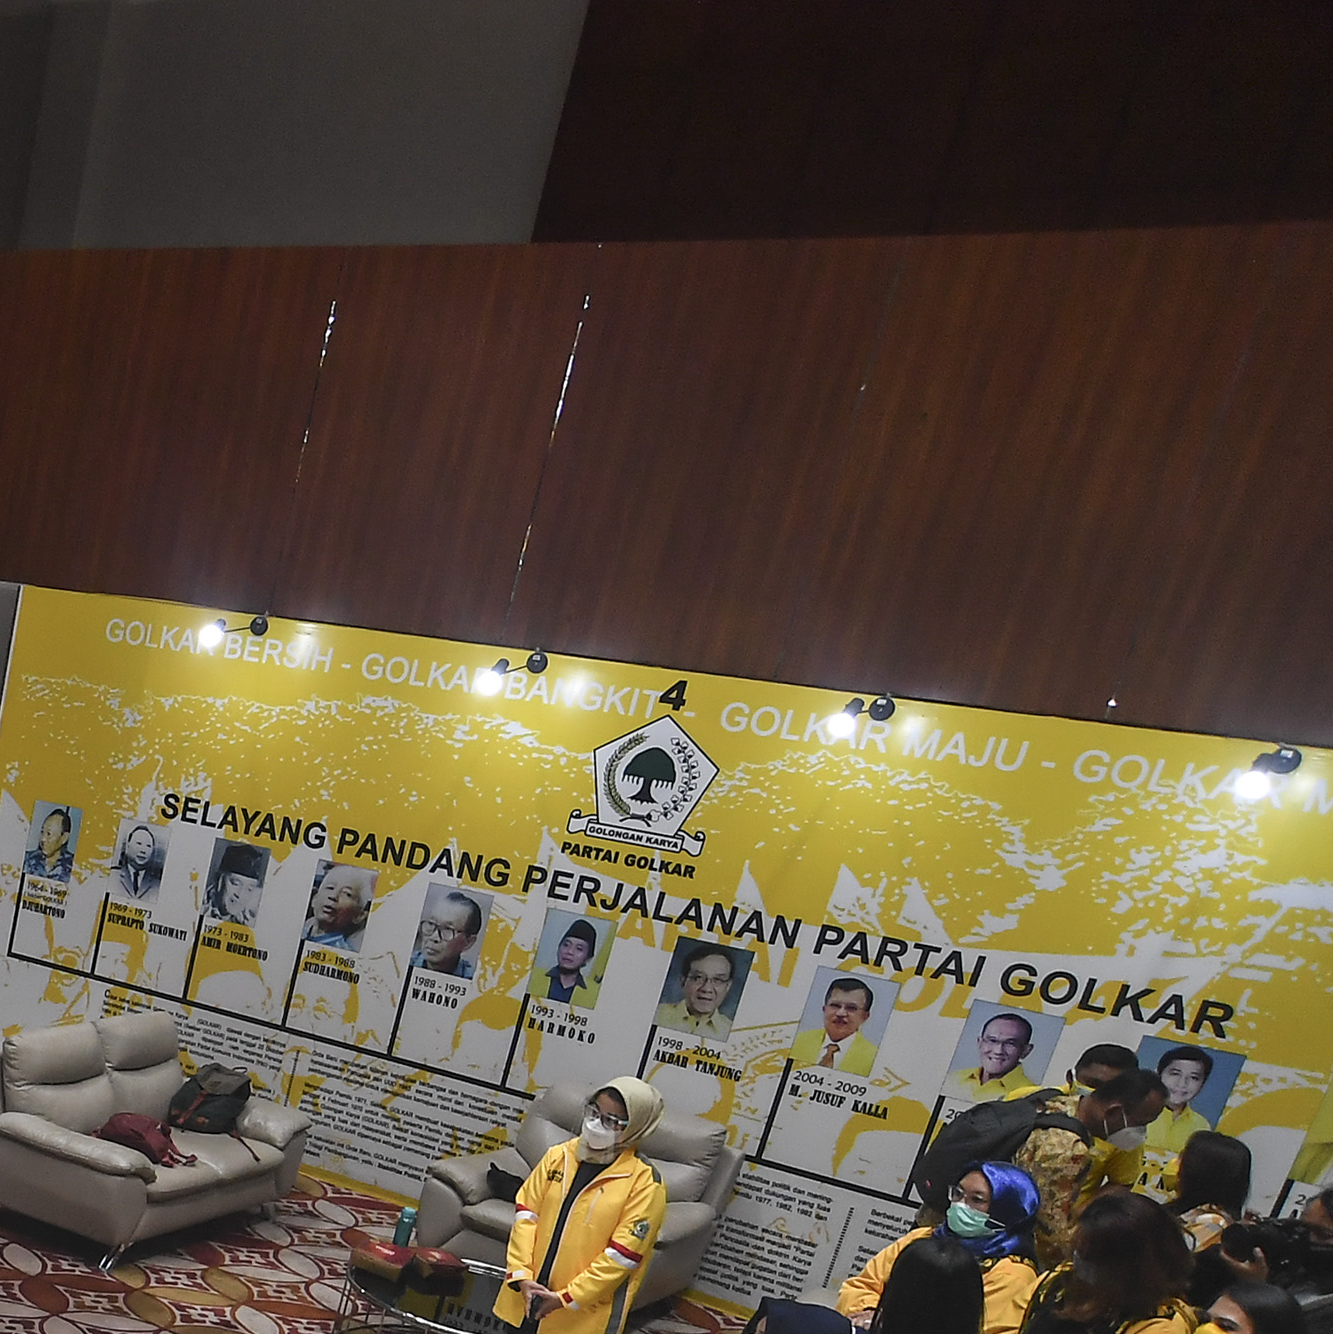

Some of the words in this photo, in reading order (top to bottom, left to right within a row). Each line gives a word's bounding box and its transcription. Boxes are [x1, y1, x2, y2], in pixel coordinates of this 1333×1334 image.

[224, 633, 334, 673] BERSIH
[361, 653, 504, 697] GOLKA
[504, 672, 662, 718] BANGKIT
[903, 717, 1028, 773] MAJU
[658, 680, 688, 711] 4
[588, 825, 643, 843] GOLONGAN
[645, 835, 679, 849] KARYA
[560, 841, 620, 864] PARTAI
[624, 854, 696, 879] GOLKAR
[107, 912, 145, 931] SUPRAPTO
[109, 901, 129, 914] 1969
[134, 907, 153, 919] 1973
[159, 792, 328, 850] SELAYANG
[335, 826, 511, 888] PANDANG
[522, 863, 801, 948] PERJALANAN
[812, 923, 987, 990] PARTAI
[999, 961, 1236, 1041] GOLKAR
[204, 924, 222, 936] 1973
[230, 930, 249, 943] 1983
[305, 949, 326, 962] 1983
[334, 955, 357, 969] 1988
[302, 961, 361, 985] SUDHARMONO
[413, 975, 436, 989] 1988
[444, 982, 467, 997] 1993
[411, 987, 458, 1010] WAHONO
[530, 1004, 554, 1019] 1993
[563, 1011, 589, 1027] 1998
[527, 1016, 596, 1045] HARMOKO
[656, 1035, 684, 1051] 1998
[692, 1043, 722, 1060] 2004
[652, 1049, 688, 1068] AKBAR
[695, 1058, 743, 1082] TANJUNG
[792, 1070, 824, 1087] 2004
[835, 1080, 867, 1097] 2009
[788, 1083, 803, 1098] M.
[809, 1090, 846, 1110] JUSUF
[851, 1099, 889, 1121] KALLA
